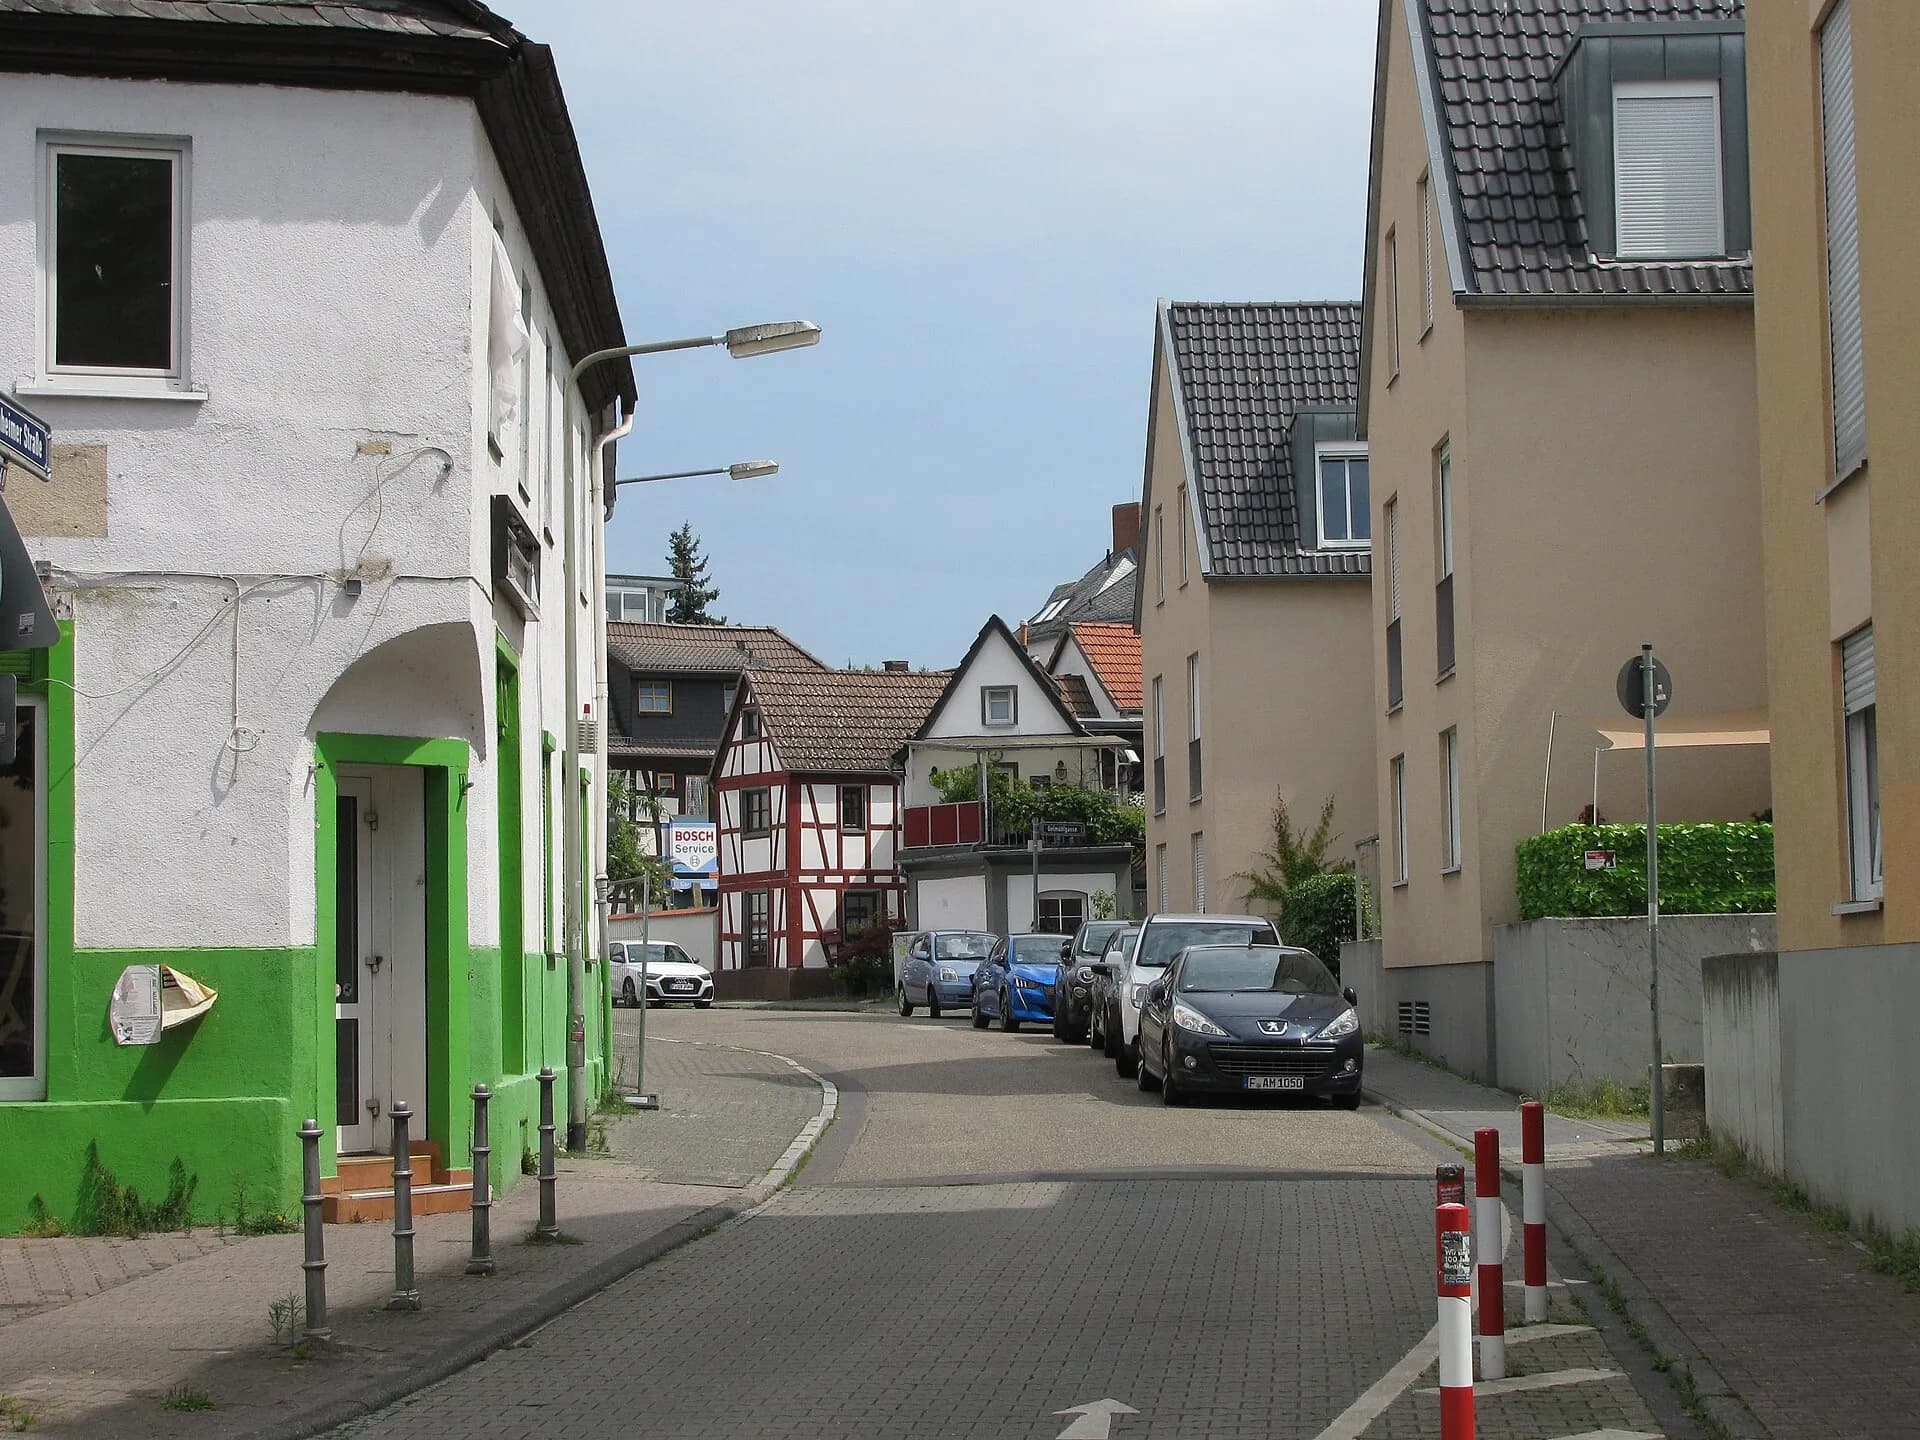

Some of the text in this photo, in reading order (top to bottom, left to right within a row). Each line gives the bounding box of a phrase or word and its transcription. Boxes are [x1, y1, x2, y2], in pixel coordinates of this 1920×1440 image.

[23, 423, 43, 459] Straße
[675, 831, 714, 842] BOSCH
[675, 844, 714, 854] Service
[1249, 1078, 1256, 1088] F
